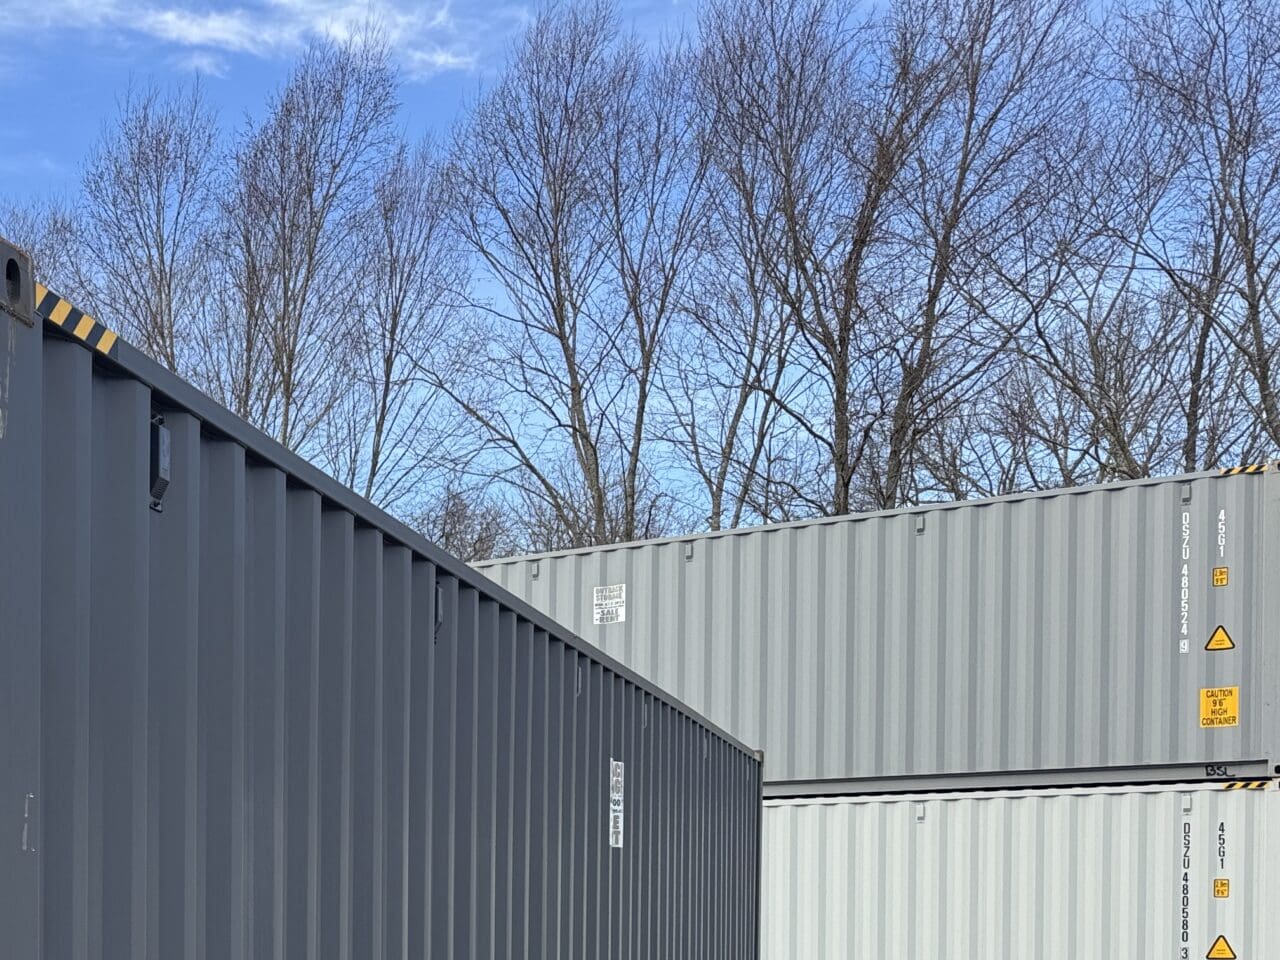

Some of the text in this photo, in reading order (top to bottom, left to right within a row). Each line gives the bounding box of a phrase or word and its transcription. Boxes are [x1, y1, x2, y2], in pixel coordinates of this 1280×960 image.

[1181, 564, 1189, 636] 480524
[1206, 689, 1233, 698] CAUTION
[1211, 708, 1227, 716] HIGH
[1201, 716, 1237, 726] CONTAINER
[1181, 872, 1189, 942] 480580
